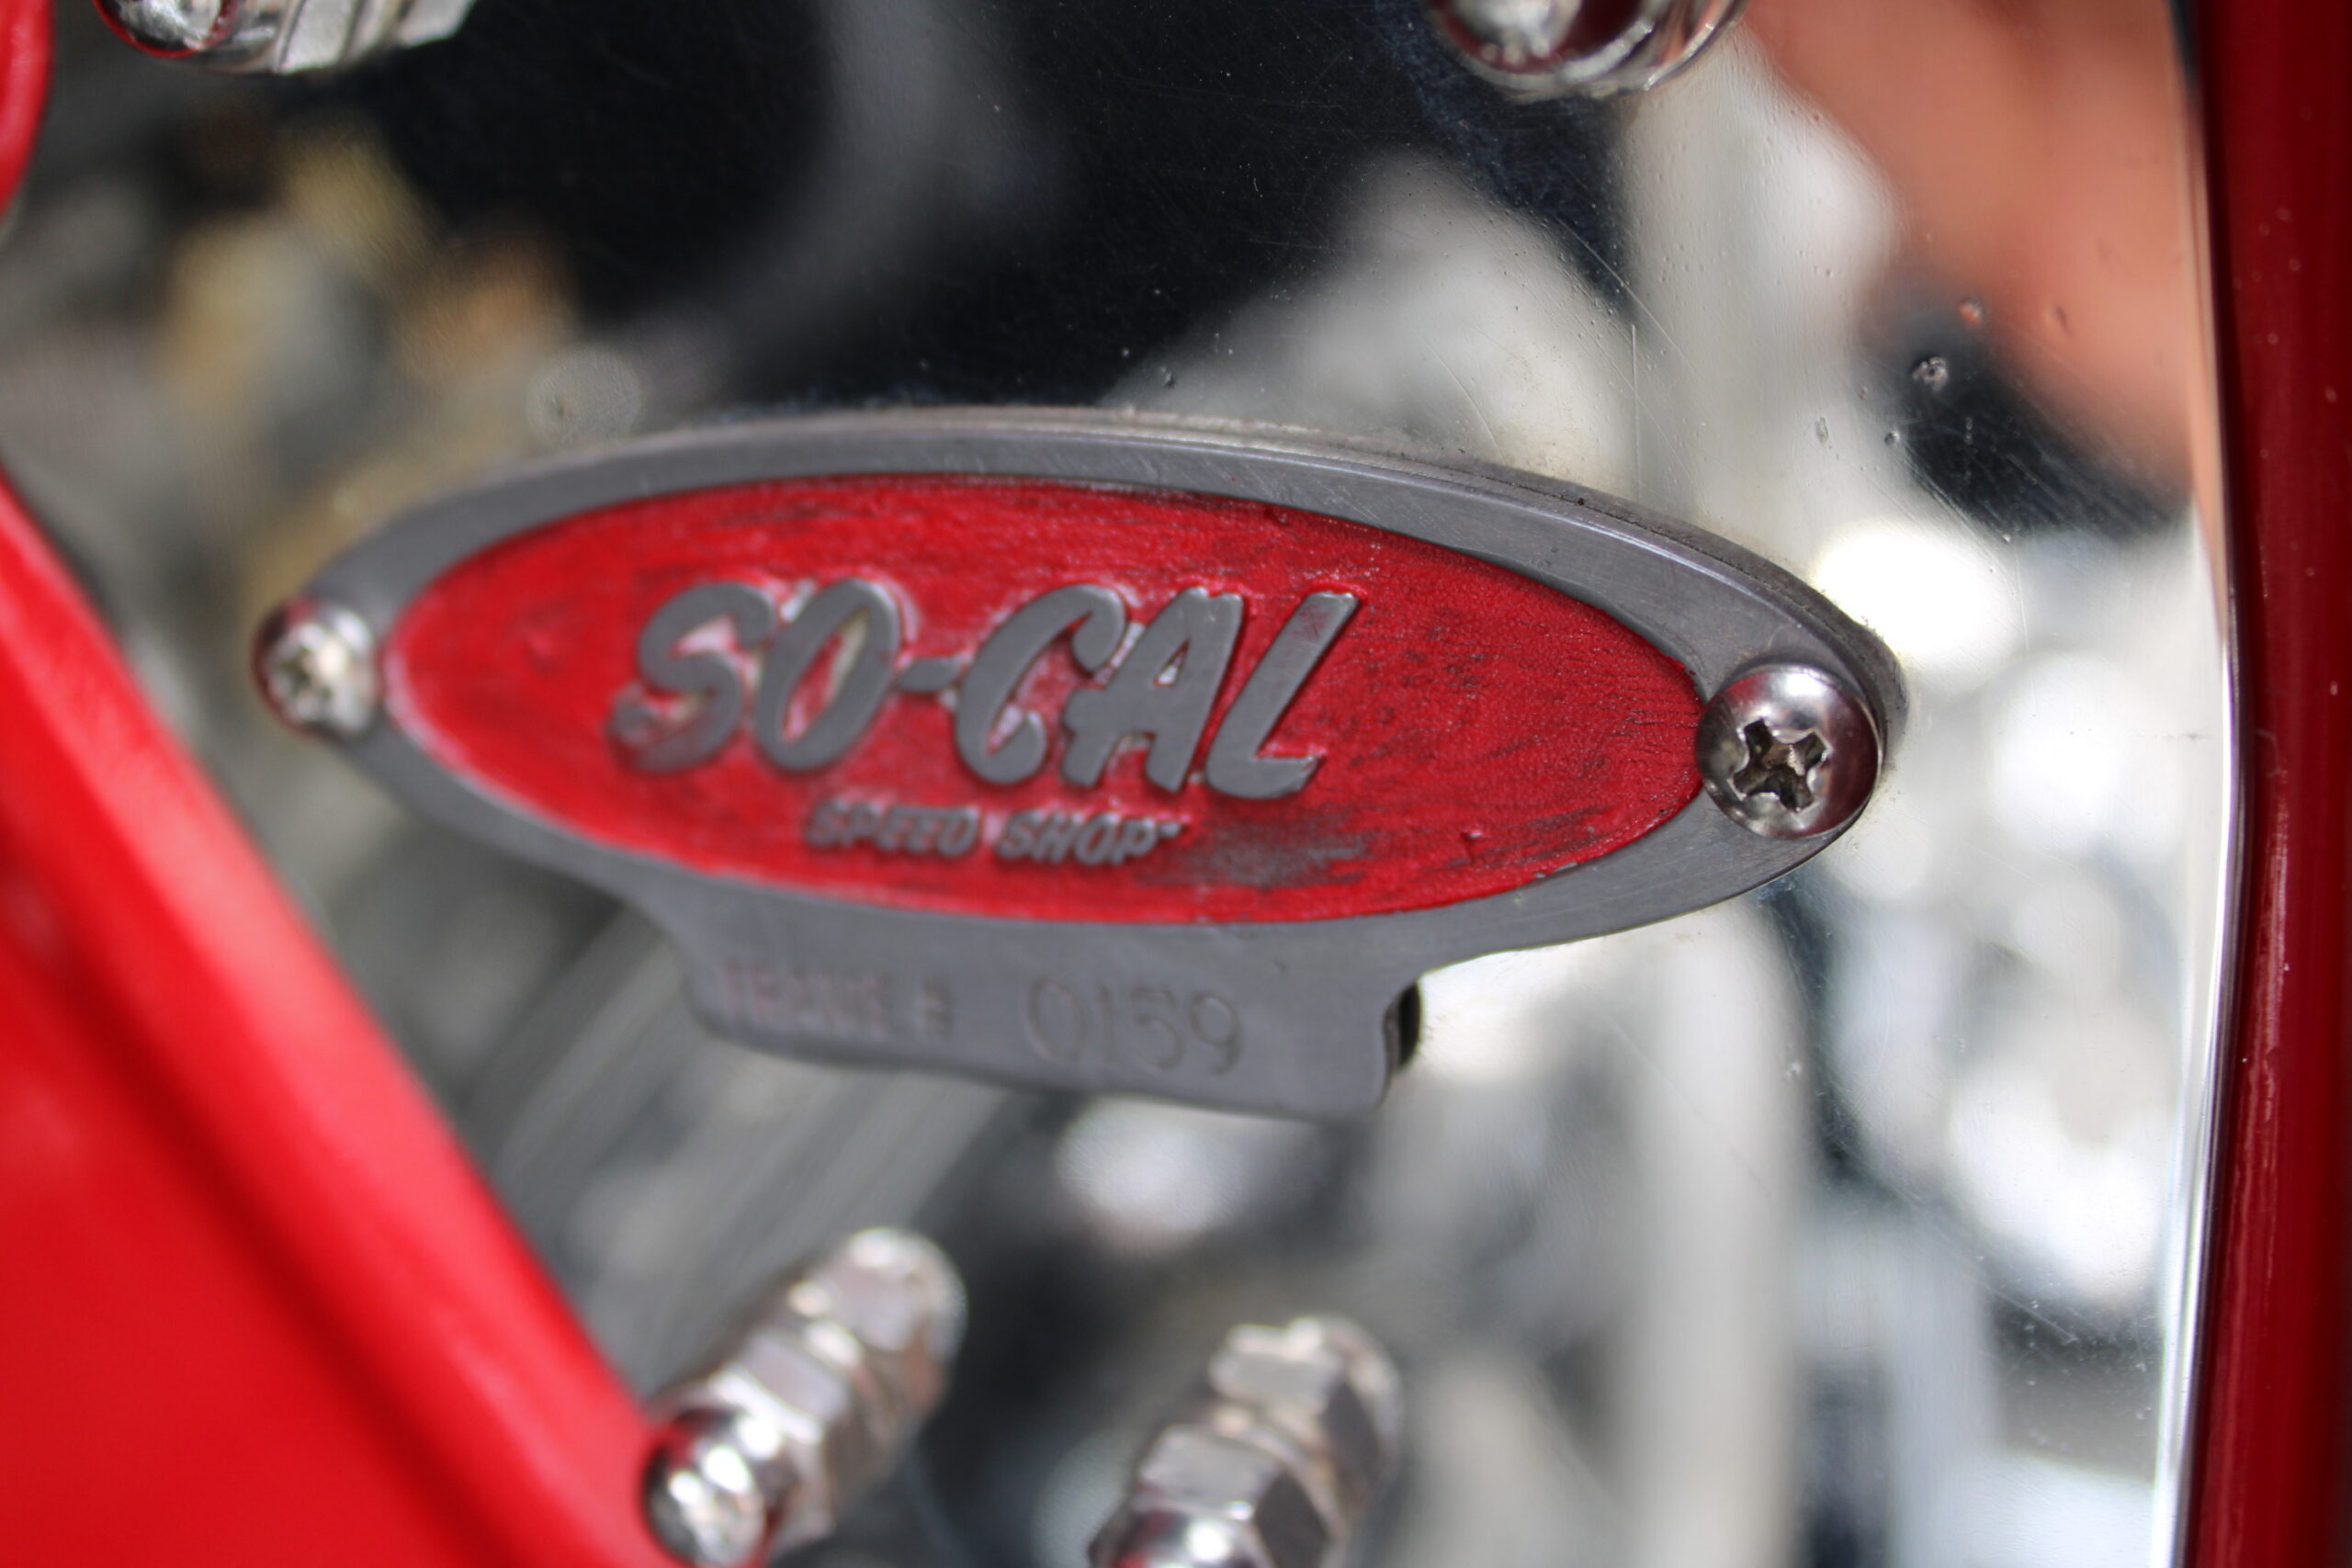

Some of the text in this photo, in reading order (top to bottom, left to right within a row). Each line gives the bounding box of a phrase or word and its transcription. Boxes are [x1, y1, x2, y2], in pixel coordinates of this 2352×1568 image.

[610, 577, 1361, 800] SO-CAL
[806, 799, 981, 860] SPEED
[1020, 979, 1245, 1077] 0159
